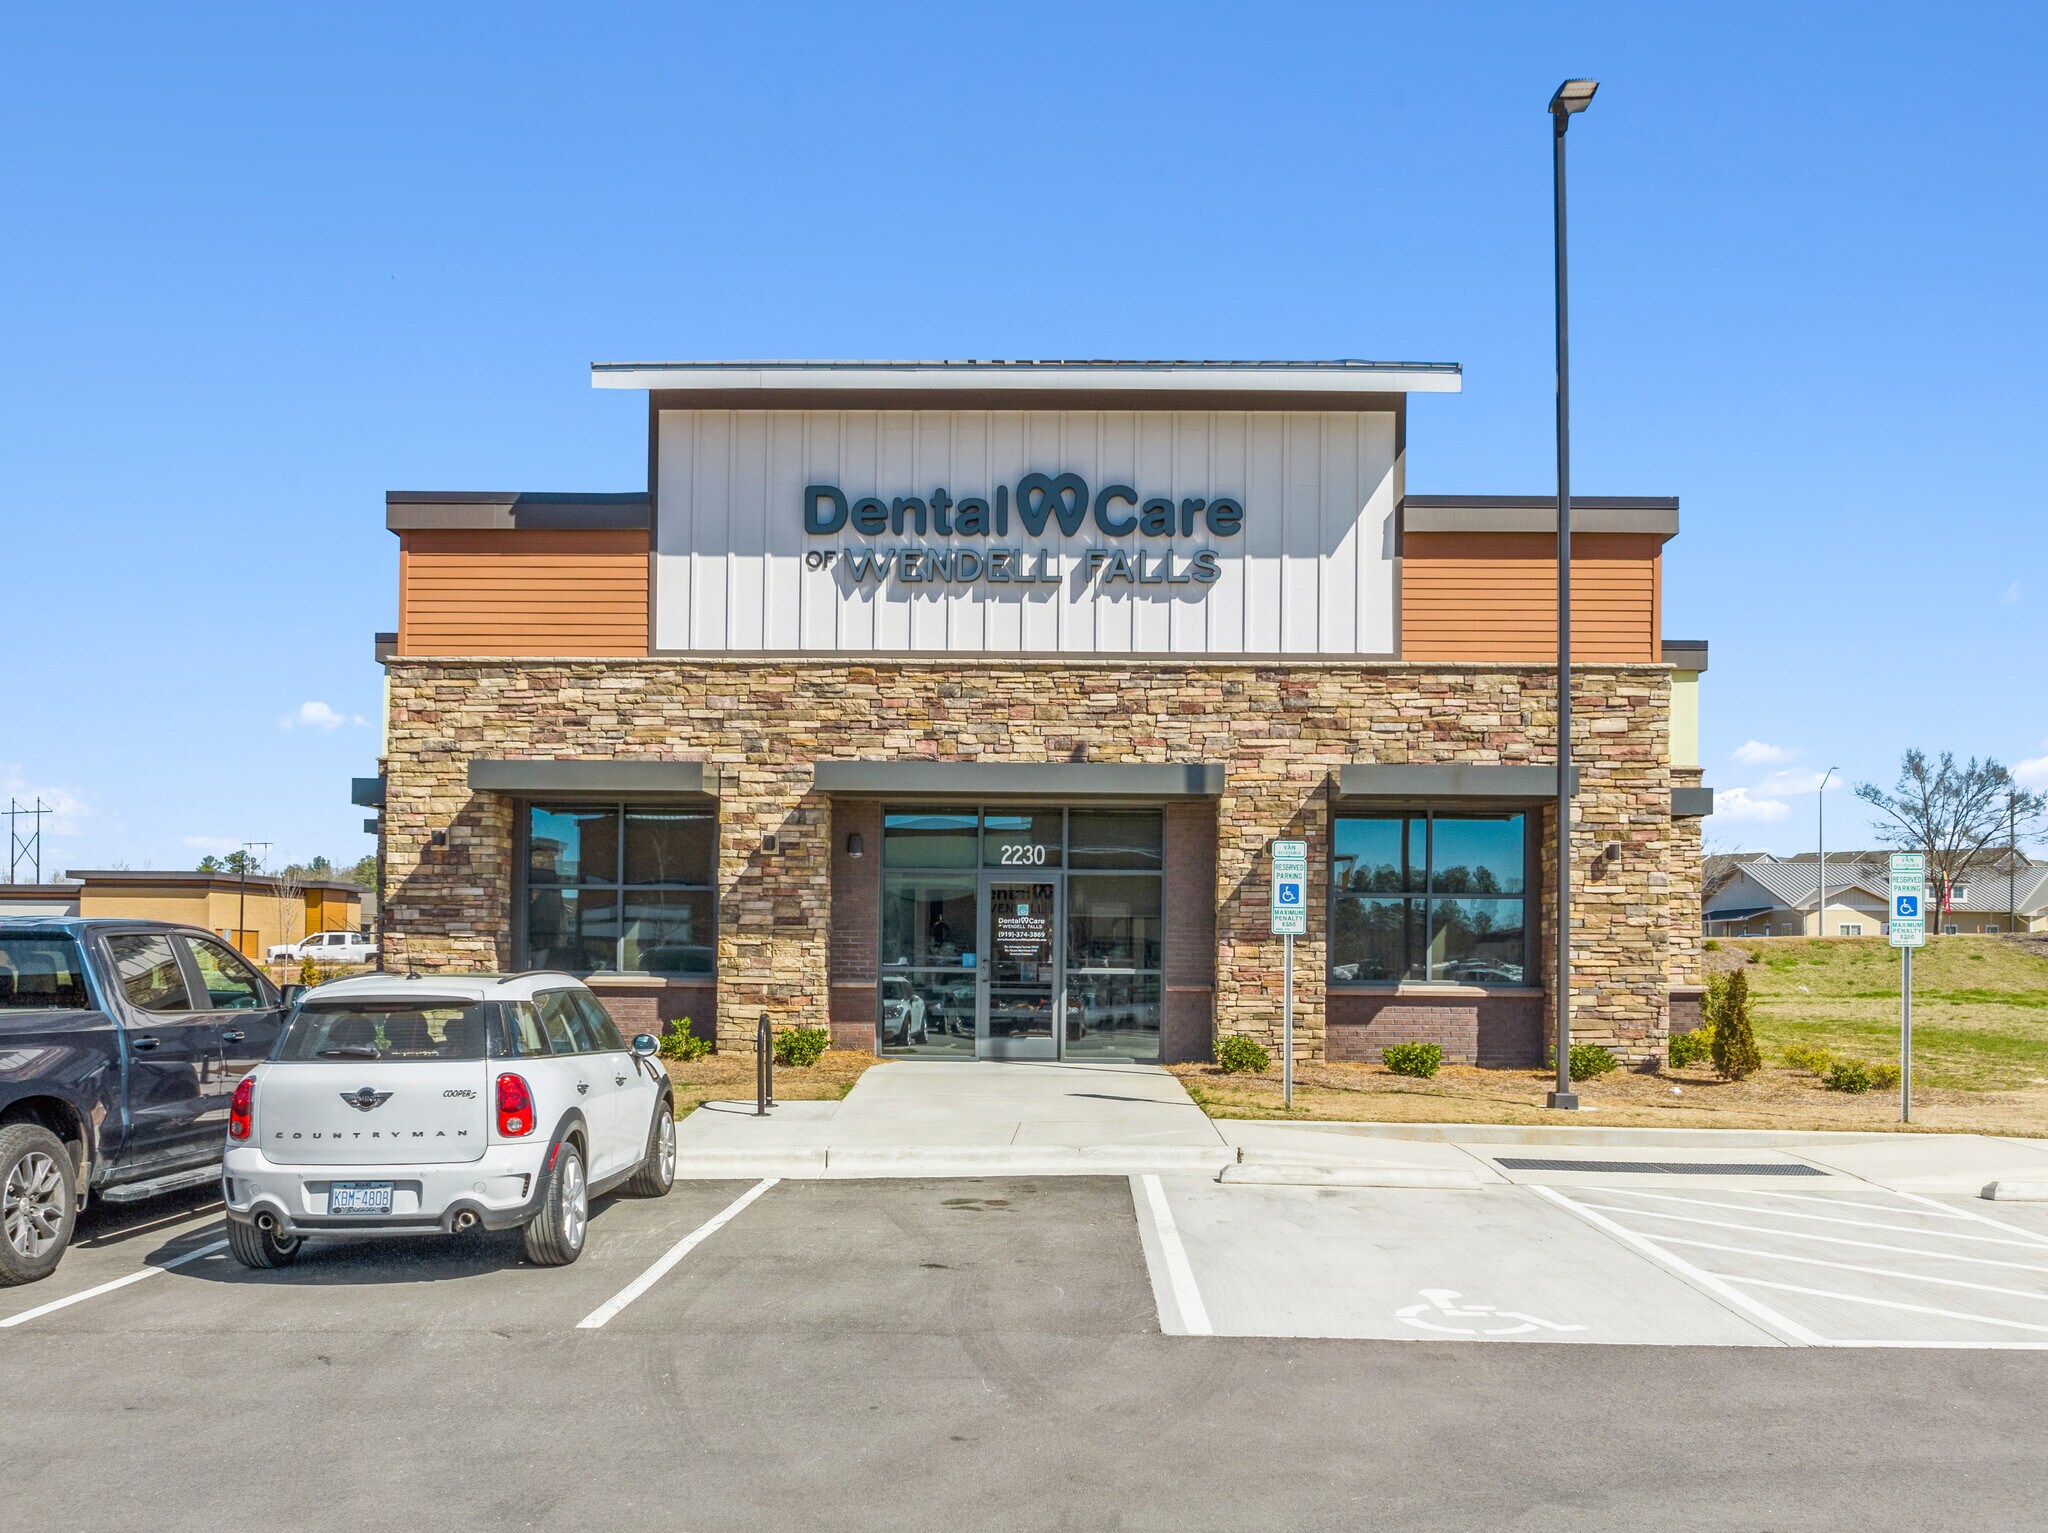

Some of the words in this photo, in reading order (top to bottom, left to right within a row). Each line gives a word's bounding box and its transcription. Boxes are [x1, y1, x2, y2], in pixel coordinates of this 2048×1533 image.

[803, 484, 1009, 536] Dental
[1094, 484, 1244, 537] Care
[805, 550, 837, 571] OF
[843, 548, 1063, 584] WENDELL
[1085, 548, 1223, 584] FALLS
[1001, 845, 1046, 865] 2230
[275, 1130, 468, 1139] COUNTRYMAN
[334, 1190, 389, 1206] KBM-4808
